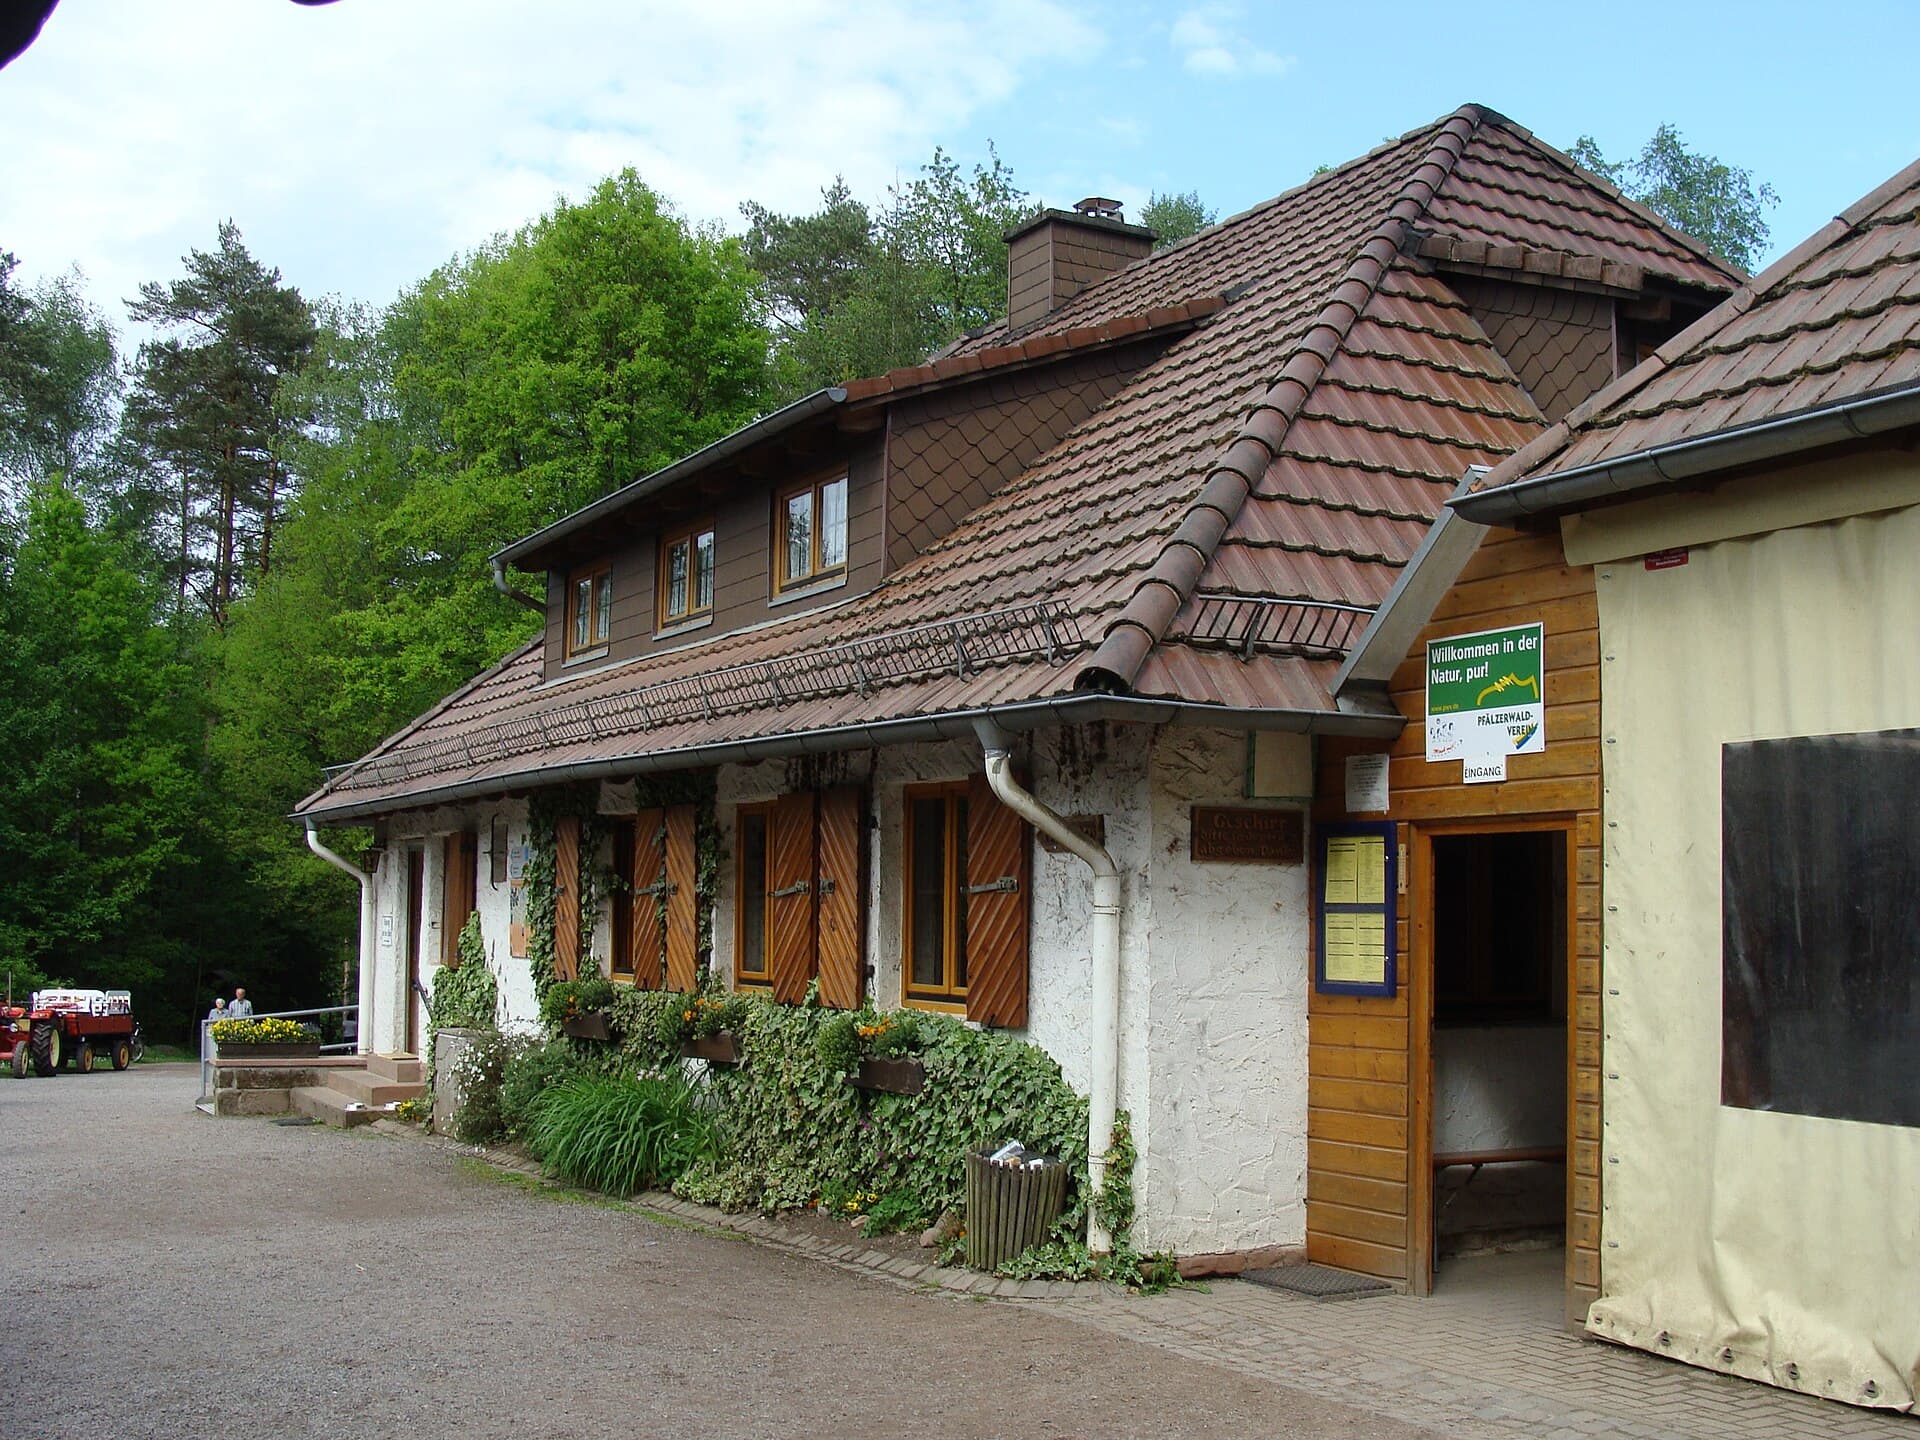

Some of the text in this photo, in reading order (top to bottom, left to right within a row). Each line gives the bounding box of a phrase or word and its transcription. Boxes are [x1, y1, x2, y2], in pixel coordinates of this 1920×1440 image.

[1431, 634, 1538, 664] Willkommen in der
[1431, 662, 1489, 684] Natur, pur!
[1477, 711, 1534, 726] PFÄLZERWALD-
[1507, 722, 1534, 736] VEREIN
[1464, 766, 1502, 778] EINGANG
